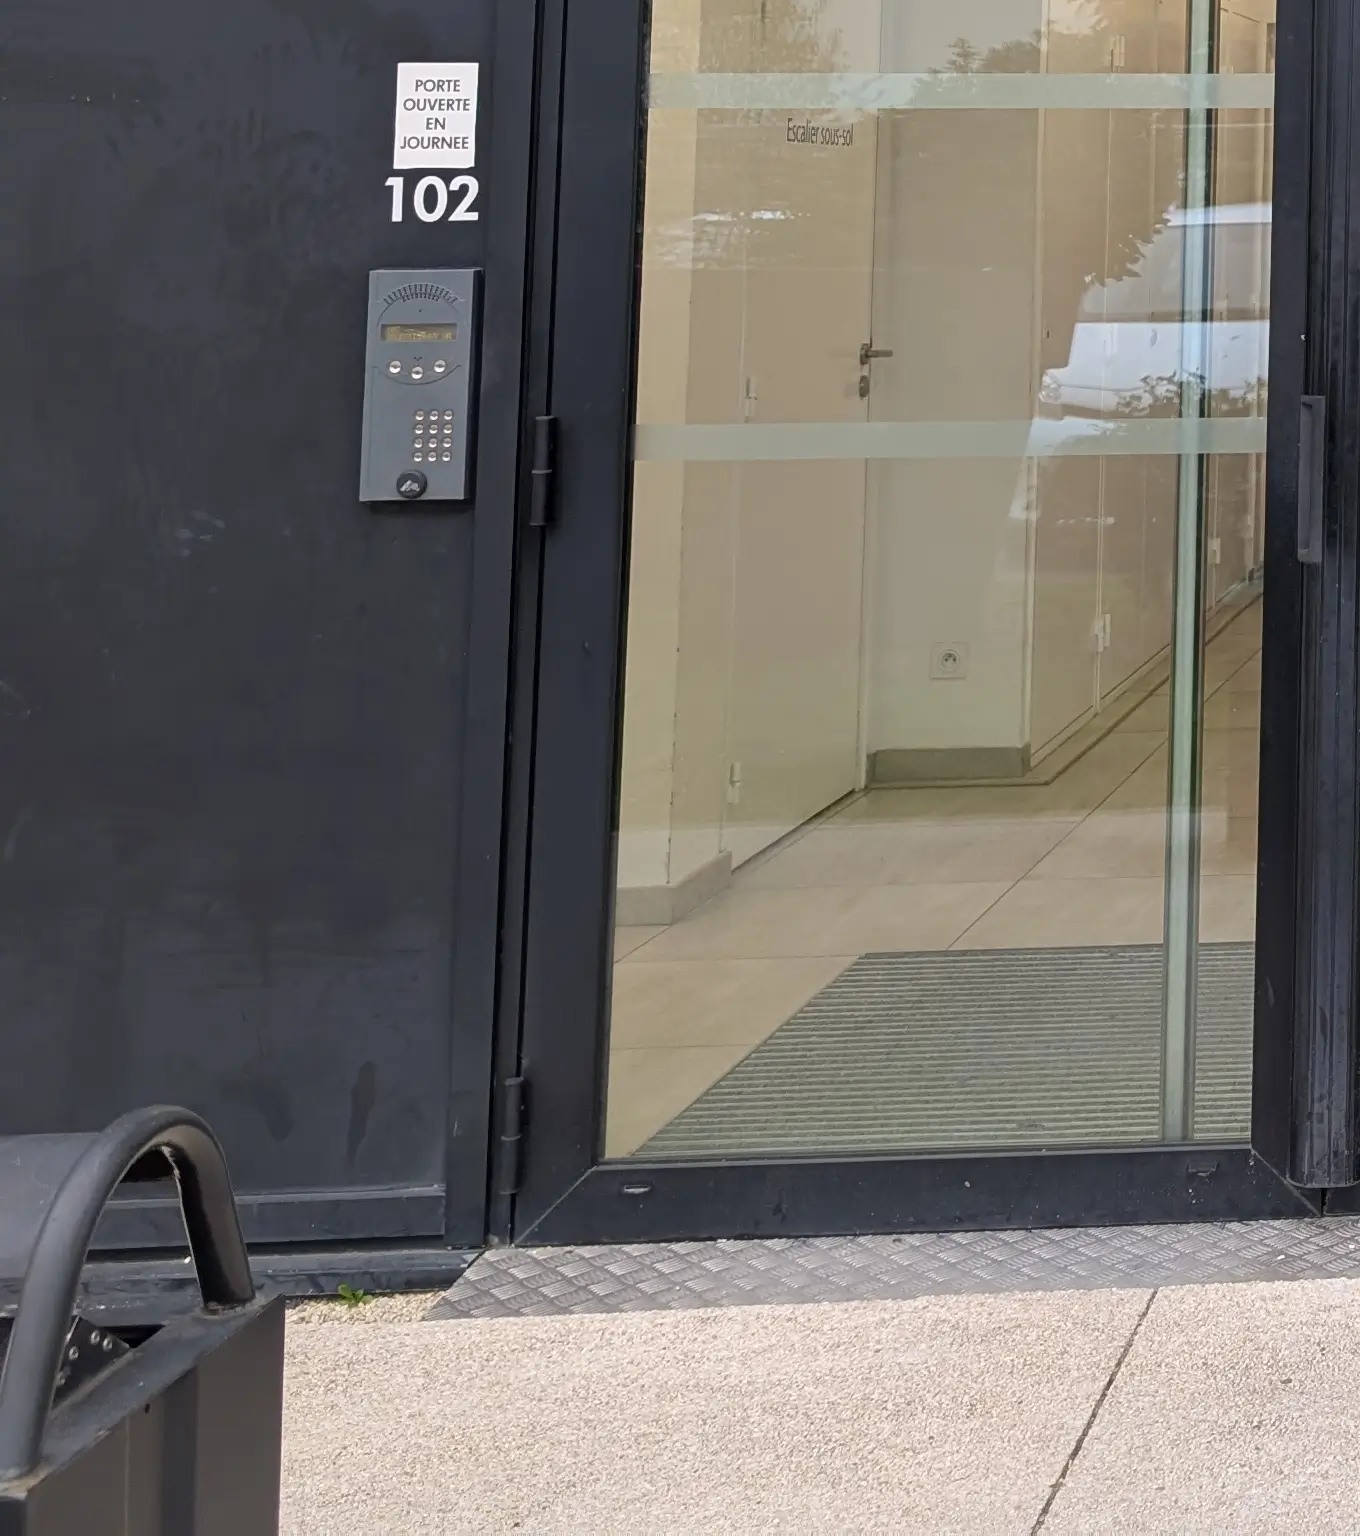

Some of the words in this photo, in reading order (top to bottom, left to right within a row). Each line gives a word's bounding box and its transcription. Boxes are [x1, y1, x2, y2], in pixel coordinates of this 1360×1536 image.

[414, 79, 461, 92] PORTE
[403, 98, 470, 112] OUVERTE
[425, 117, 446, 130] EN
[786, 117, 820, 144] Escalier
[400, 136, 469, 150] JOURNEE
[384, 175, 479, 223] 102
